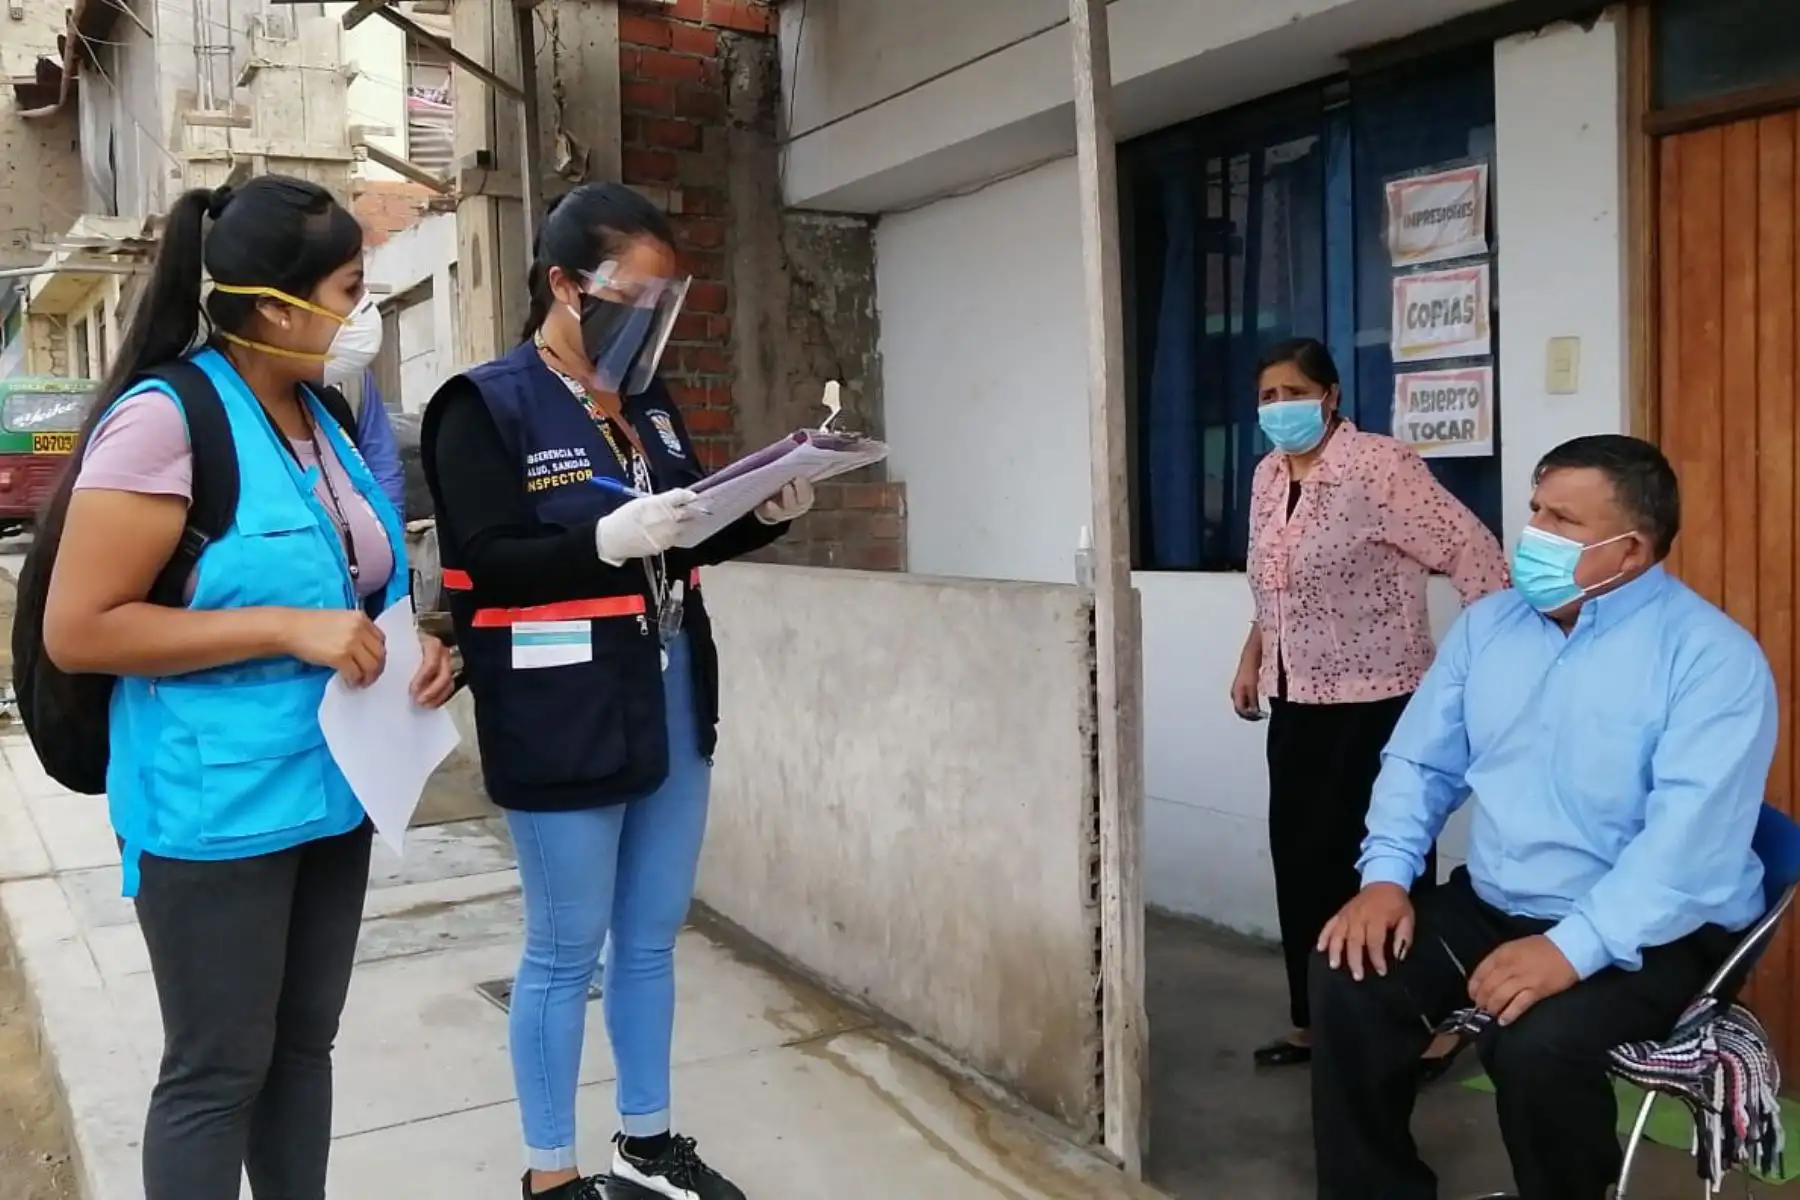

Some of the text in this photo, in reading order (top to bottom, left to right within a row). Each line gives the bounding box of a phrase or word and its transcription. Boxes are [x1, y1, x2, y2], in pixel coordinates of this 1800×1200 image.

[1406, 294, 1474, 330] COPIAS
[1408, 419, 1475, 441] TOCAR
[528, 464, 551, 477] ALUD,
[528, 468, 593, 493] NSPECTOR
